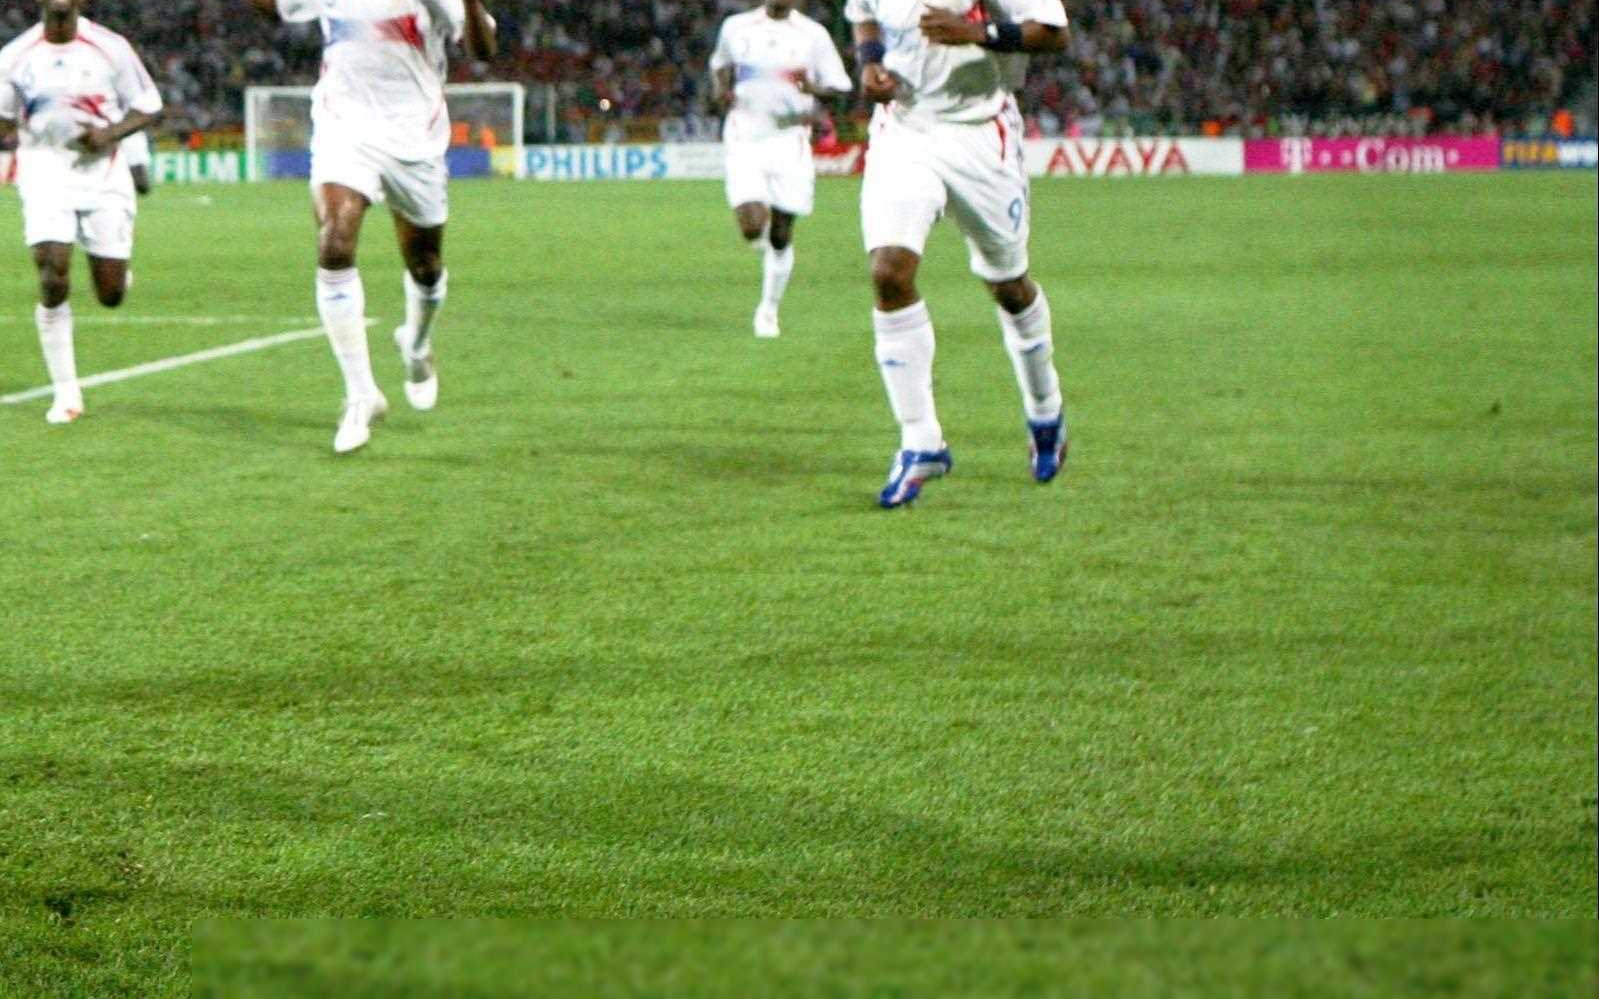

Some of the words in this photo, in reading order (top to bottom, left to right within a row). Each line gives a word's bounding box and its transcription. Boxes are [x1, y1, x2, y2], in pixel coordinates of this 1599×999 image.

[526, 145, 669, 180] PHILIPS
[1046, 138, 1191, 175] AVAYA
[1007, 197, 1023, 234] 9
